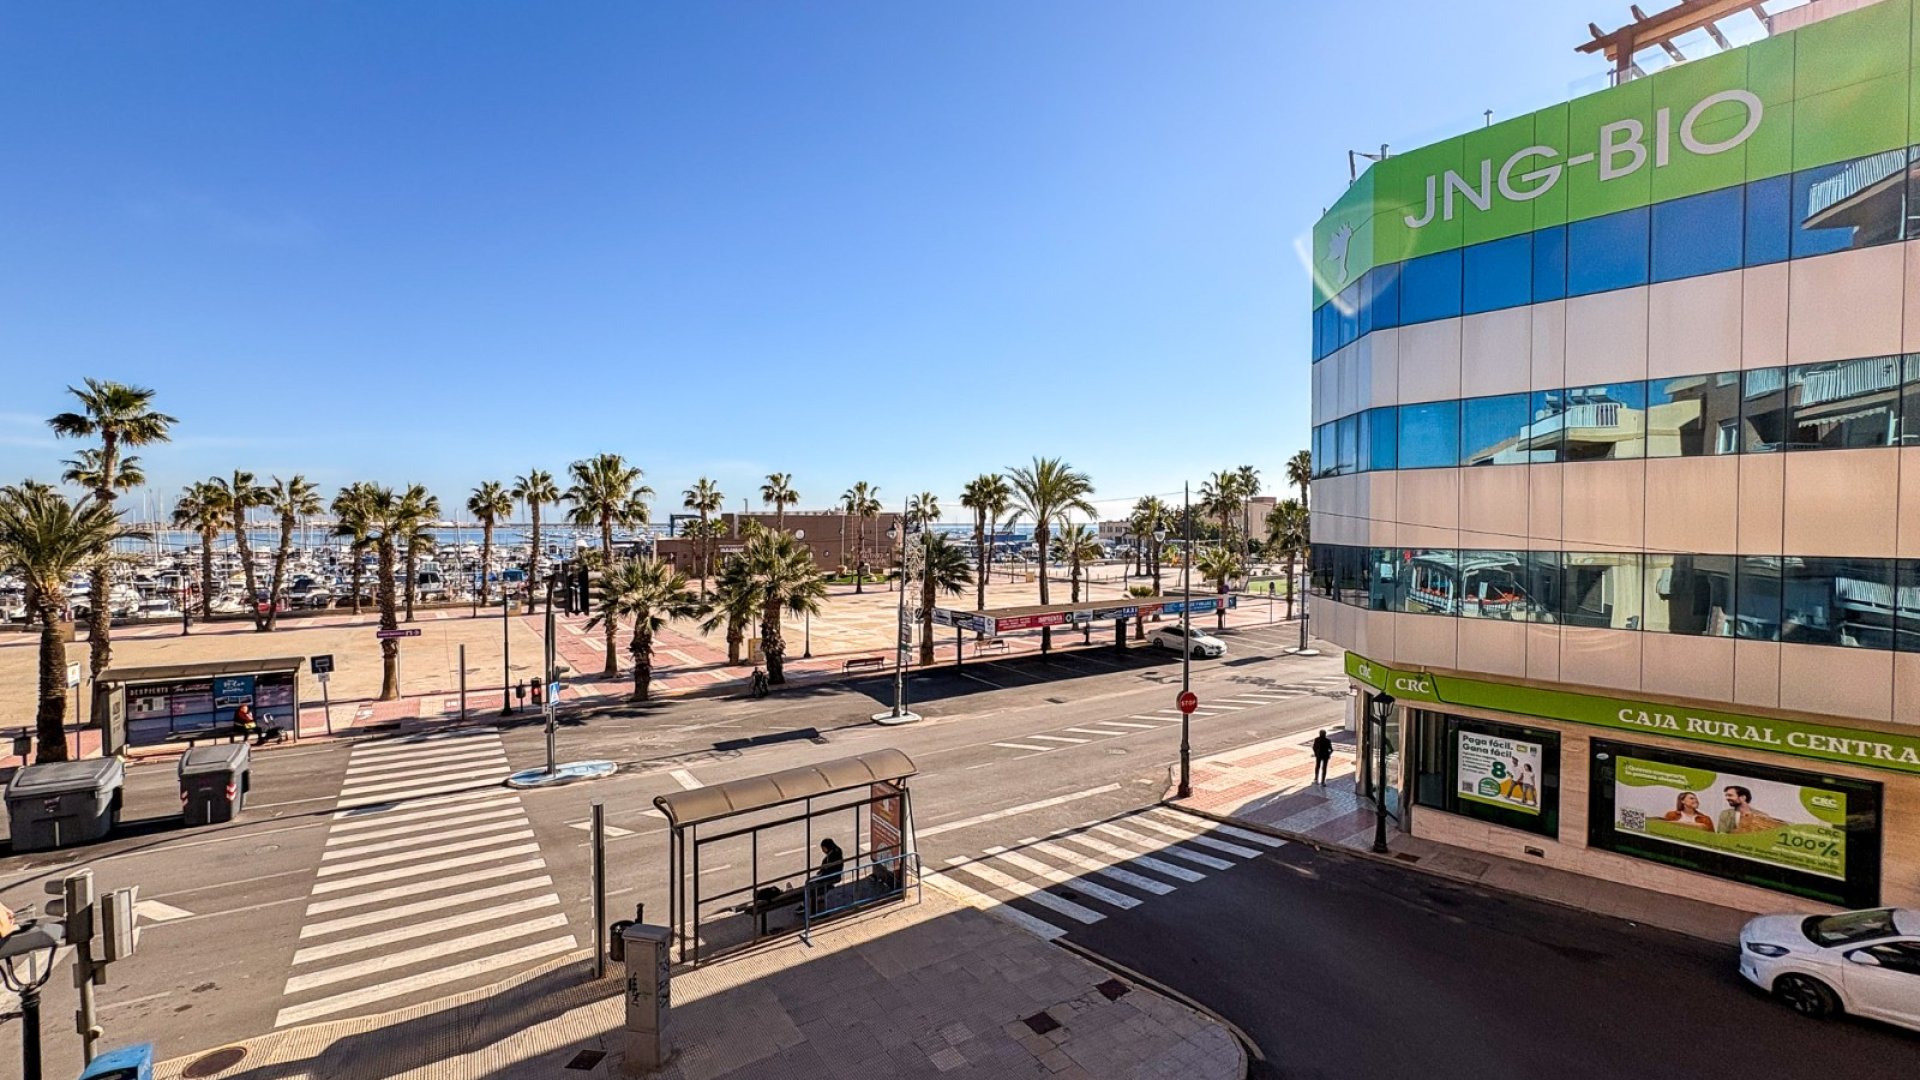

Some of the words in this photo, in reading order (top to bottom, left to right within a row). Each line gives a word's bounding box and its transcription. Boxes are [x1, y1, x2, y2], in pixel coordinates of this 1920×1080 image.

[1403, 89, 1764, 229] JNG-BIO
[1395, 678, 1430, 694] CRC
[1462, 735, 1488, 747] Paga
[1618, 708, 1681, 730] CAJA
[1686, 716, 1781, 745] RURAL
[1787, 732, 1920, 764] CENTRA
[1462, 743, 1489, 754] Gana
[1811, 796, 1838, 807] CRC
[1817, 828, 1840, 838] CRC
[1776, 833, 1840, 857] 100%
